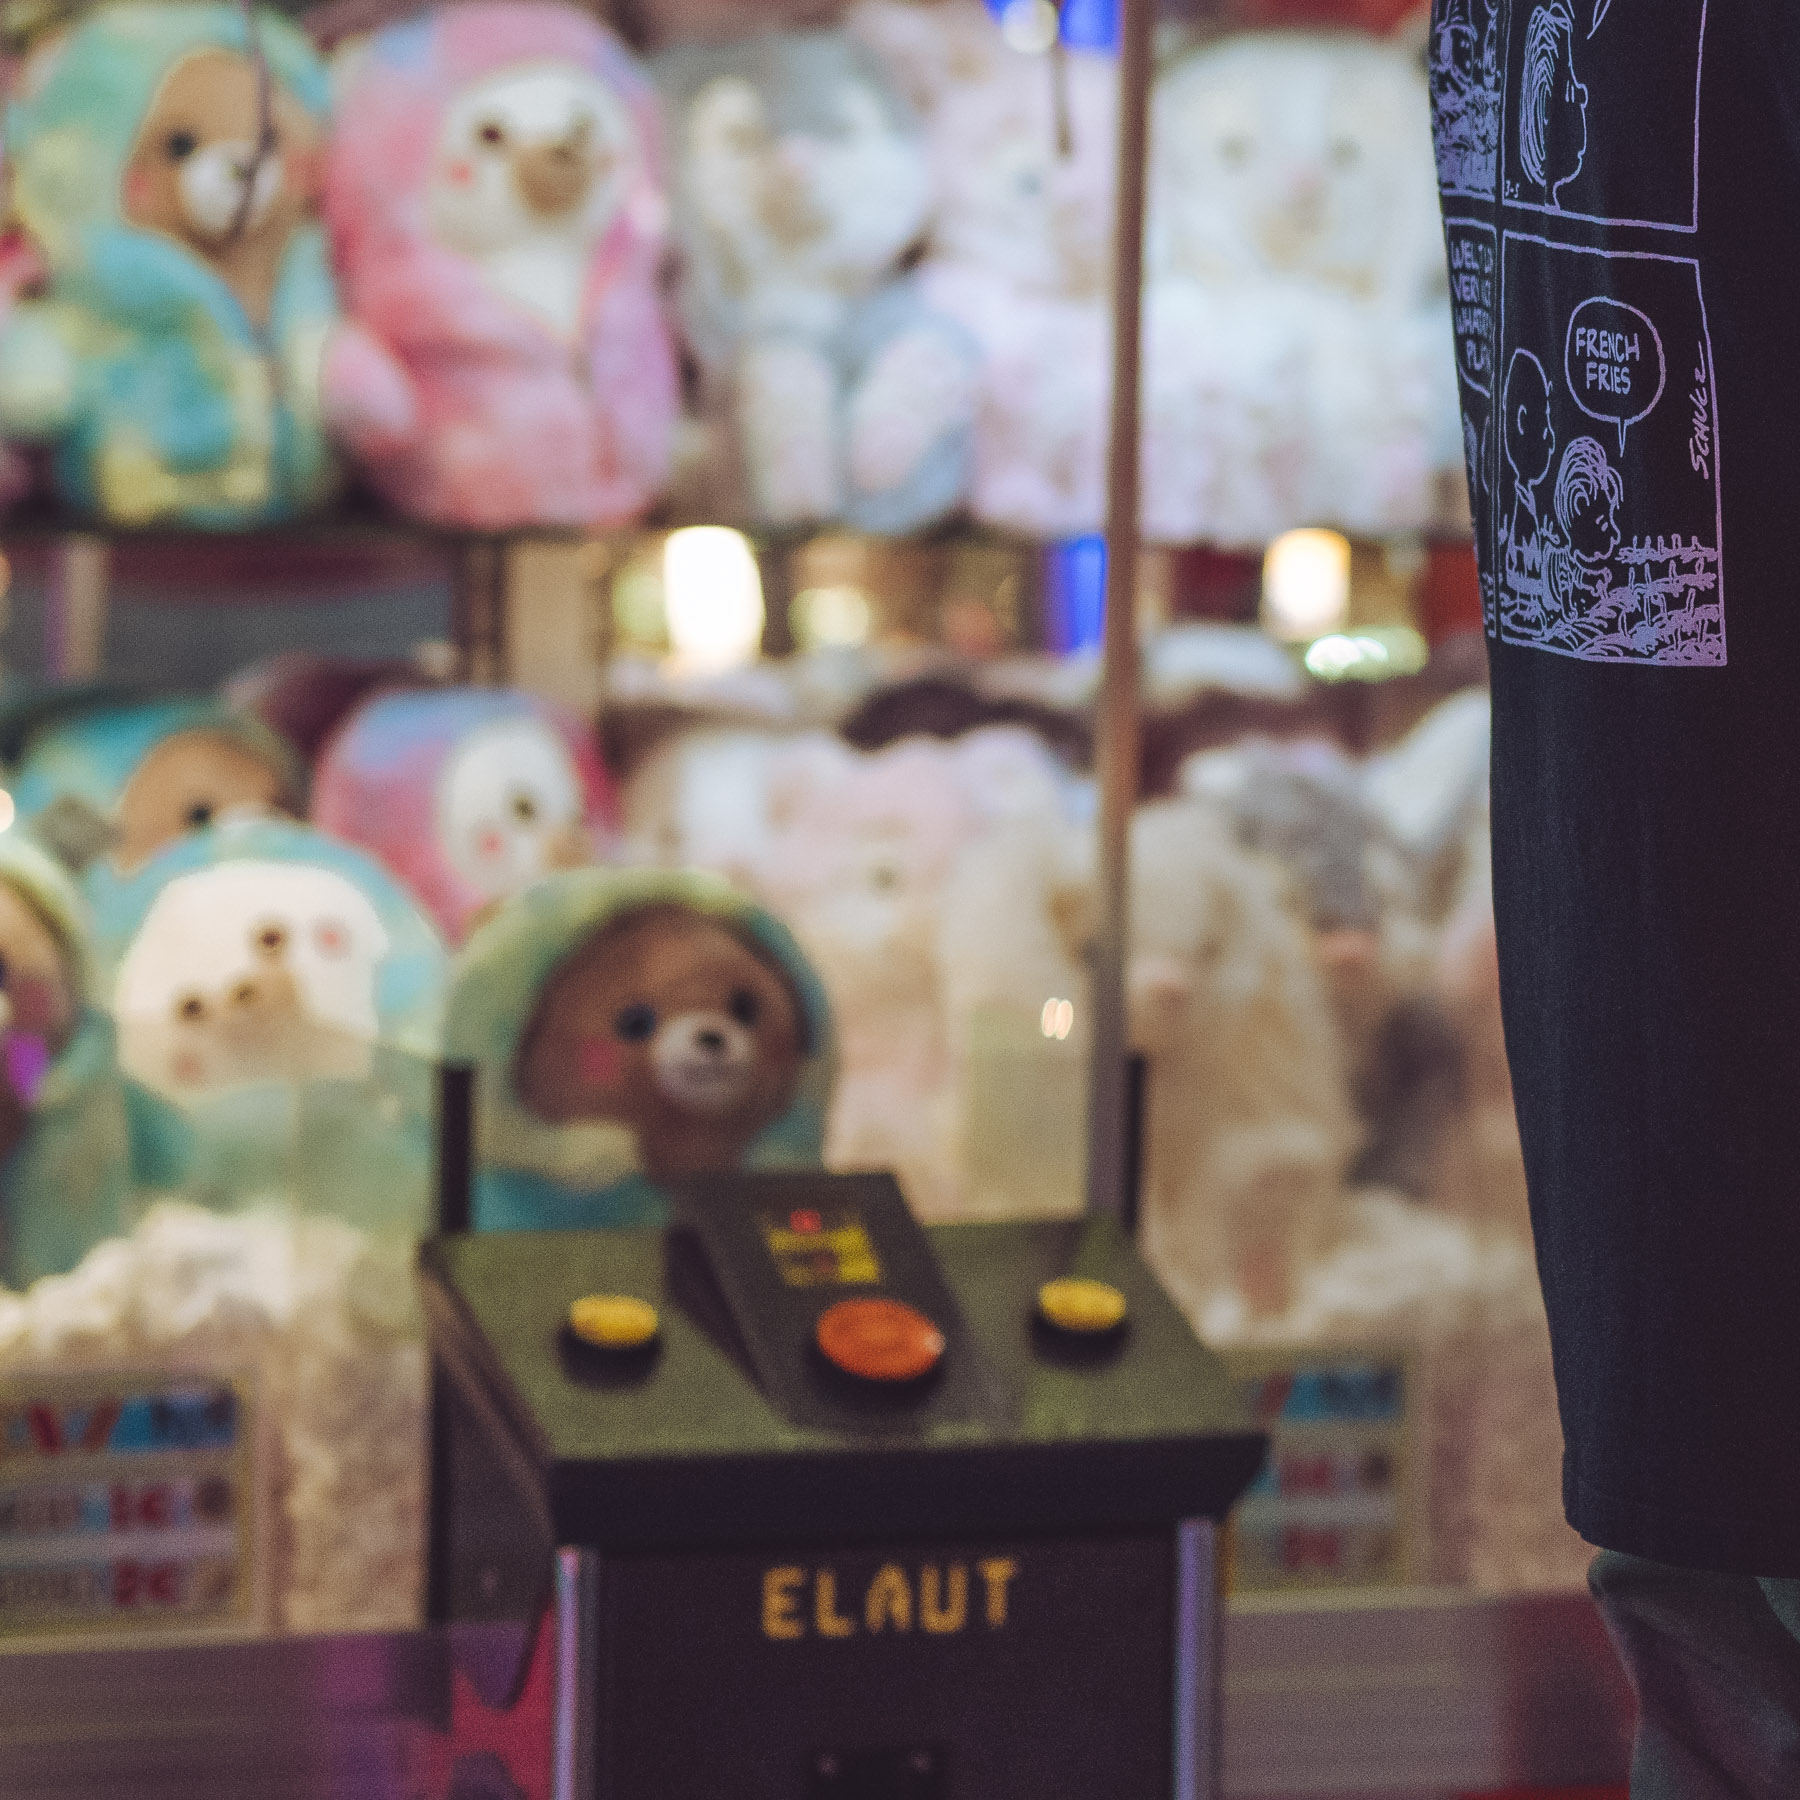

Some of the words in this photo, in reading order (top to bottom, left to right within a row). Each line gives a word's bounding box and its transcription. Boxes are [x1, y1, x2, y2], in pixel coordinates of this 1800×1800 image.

[1575, 327, 1641, 363] FRENCH
[1586, 361, 1632, 395] FRIES
[760, 1554, 1020, 1640] ELAUT
